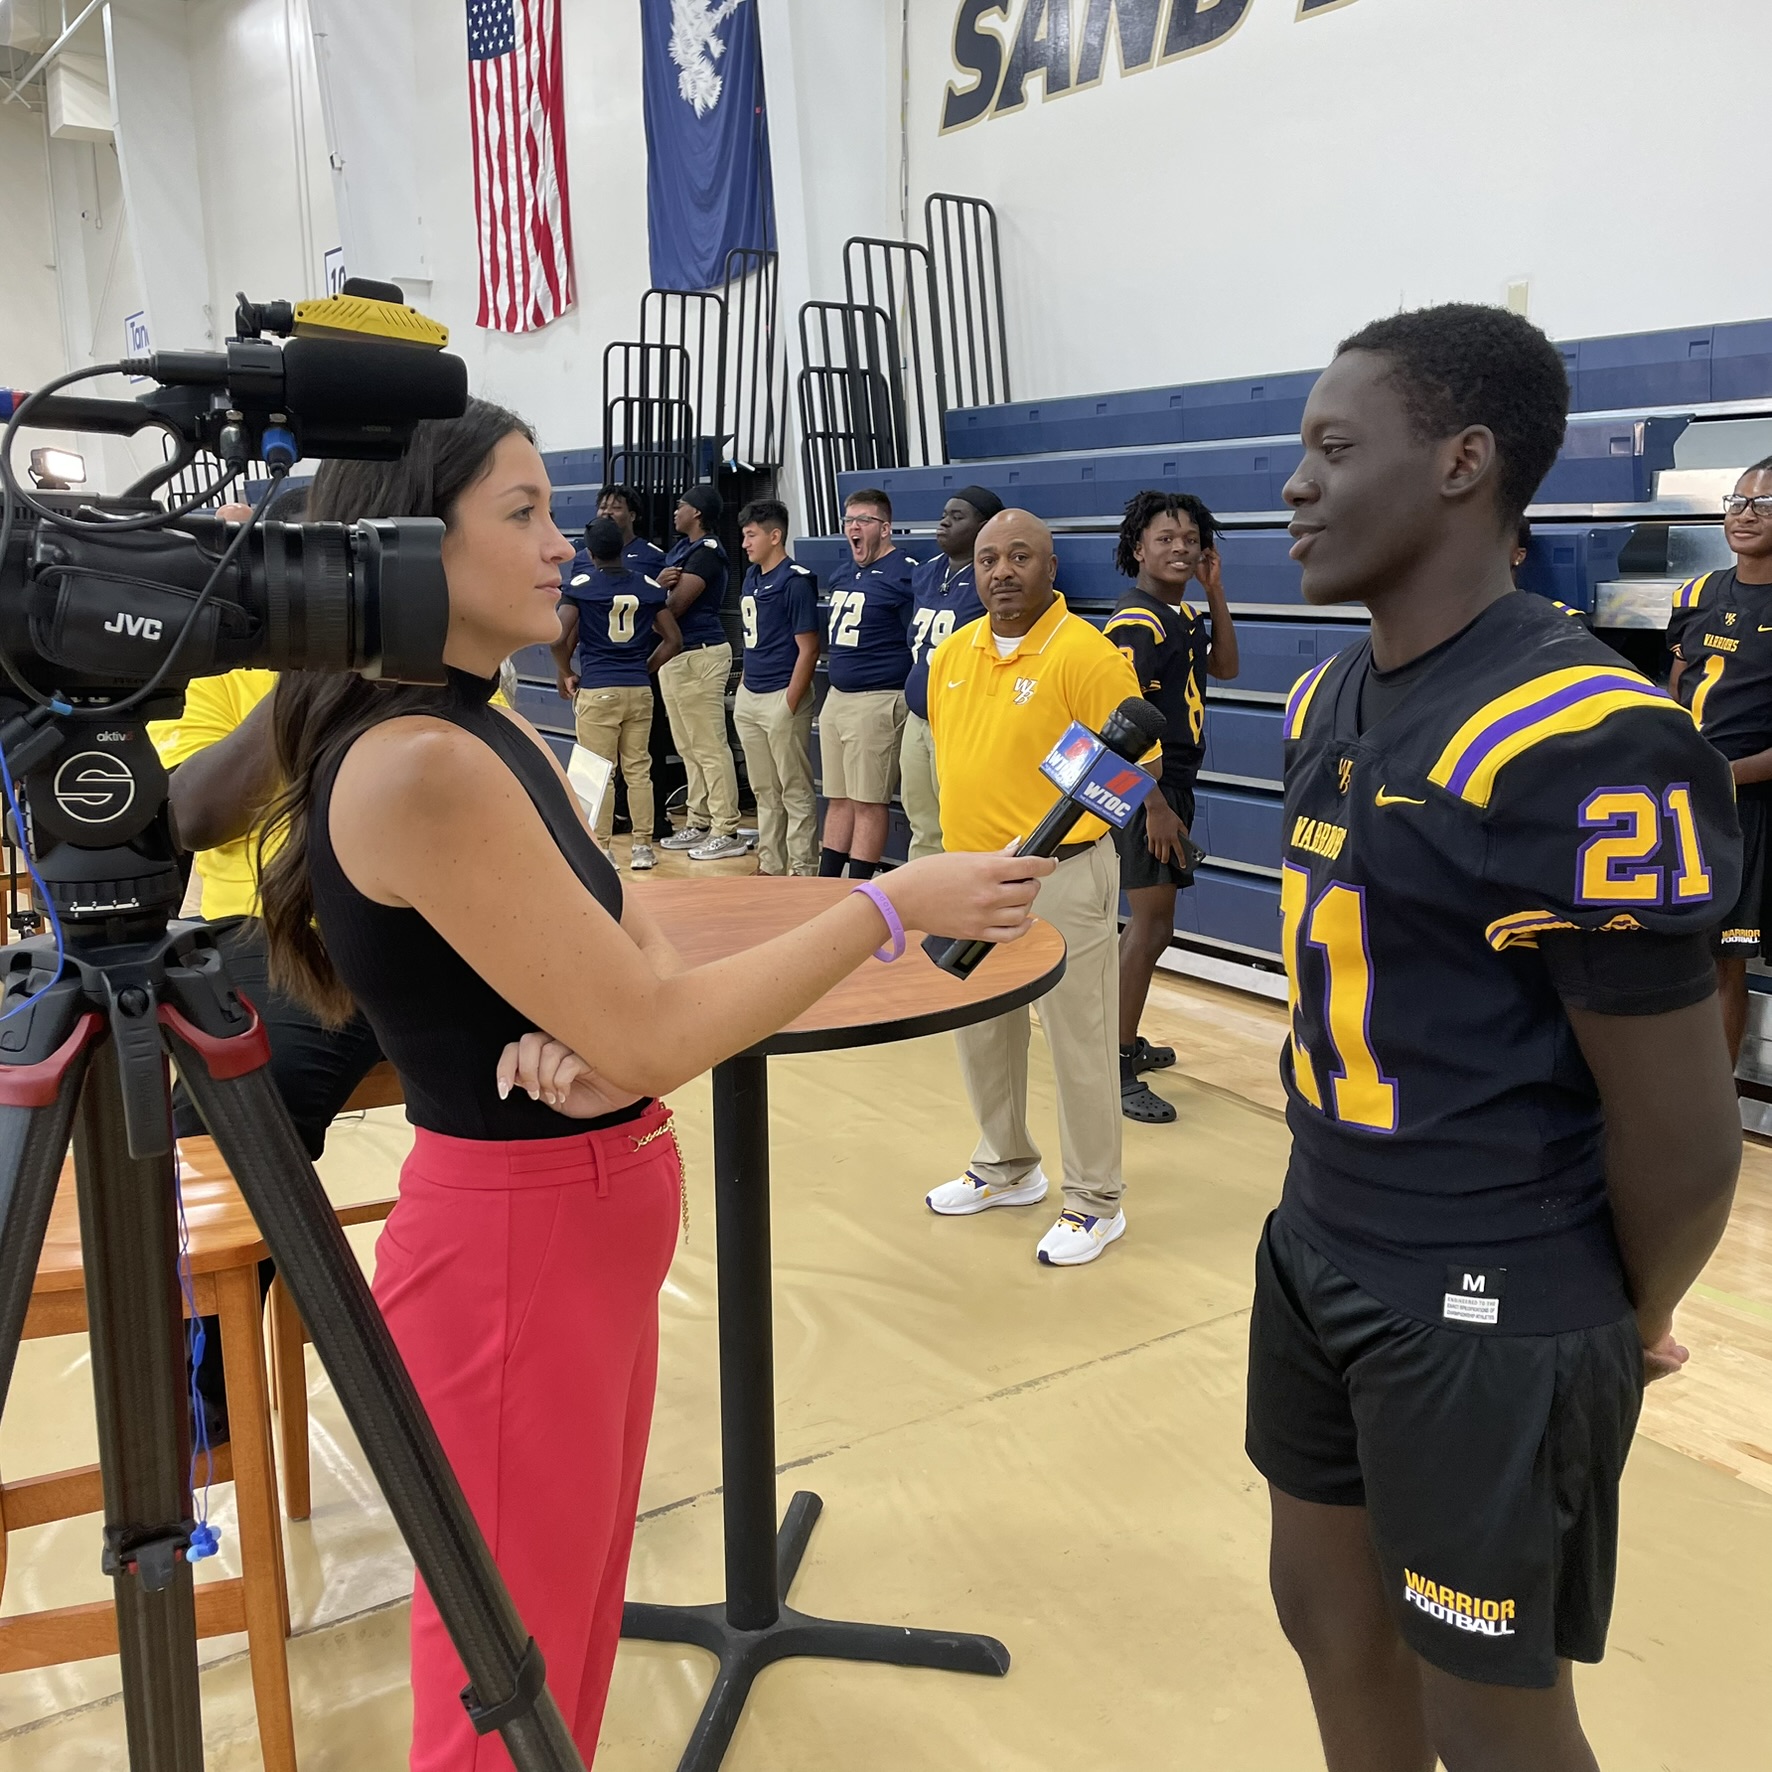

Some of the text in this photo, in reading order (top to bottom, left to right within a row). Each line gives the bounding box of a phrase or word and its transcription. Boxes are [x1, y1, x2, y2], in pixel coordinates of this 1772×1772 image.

[938, 0, 1255, 137] SAND
[104, 612, 163, 640] JVC
[608, 594, 640, 643] 0
[740, 595, 758, 649] 9
[828, 590, 866, 647] 72
[1083, 781, 1131, 818] WTOC
[1574, 782, 1713, 906] 21
[1722, 929, 1760, 938] WARRIOR
[1463, 1273, 1486, 1293] M
[1404, 1567, 1515, 1621] WARRIOR
[1405, 1585, 1515, 1636] FOOTBALL
